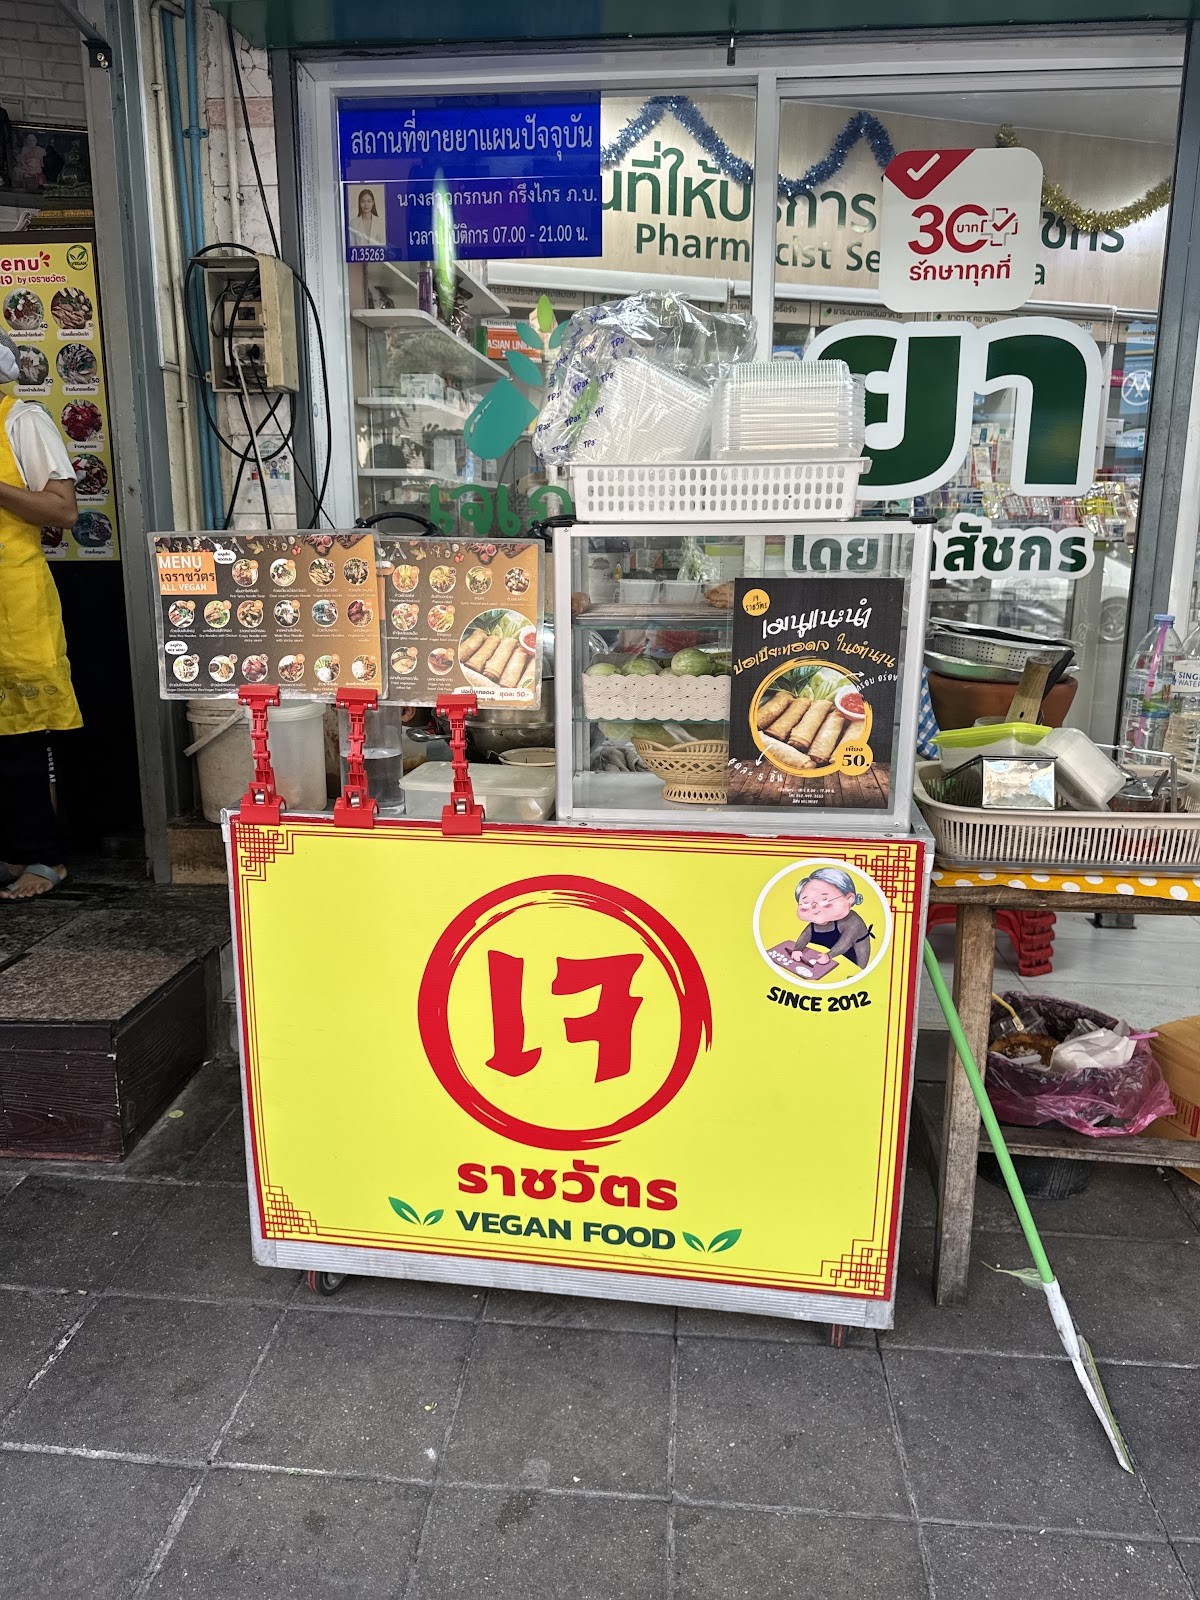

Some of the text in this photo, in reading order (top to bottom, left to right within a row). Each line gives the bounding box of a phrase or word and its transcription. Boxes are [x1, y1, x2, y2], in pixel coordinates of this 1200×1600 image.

[351, 110, 593, 161] สถานที่ขายยาแผนปัจจุบัน
[492, 225, 525, 243] 07.00
[539, 224, 572, 242] 21.00
[956, 222, 977, 233] บาท
[636, 223, 832, 270] Pharmcist
[1, 258, 39, 271] enu
[909, 254, 1012, 287] รักษาทุกที่
[17, 276, 27, 285] by
[486, 319, 518, 328] Dimenhy
[487, 339, 510, 350] ASIAN
[572, 378, 590, 393] TPax
[564, 412, 582, 428] TPax
[160, 555, 203, 569] MENU
[160, 568, 215, 582] เจราชวัตร
[161, 583, 207, 591] ALL VEGAN
[762, 598, 873, 639] เมนูแนะนำ
[836, 633, 897, 669] ในตำนาน
[1178, 671, 1200, 680] SING
[757, 773, 764, 781] 5
[766, 986, 872, 1012] SINCE 2012
[485, 949, 645, 1084] เจ
[456, 1158, 678, 1212] ราชวัตร
[455, 1209, 677, 1251] VEGAN FOOD
